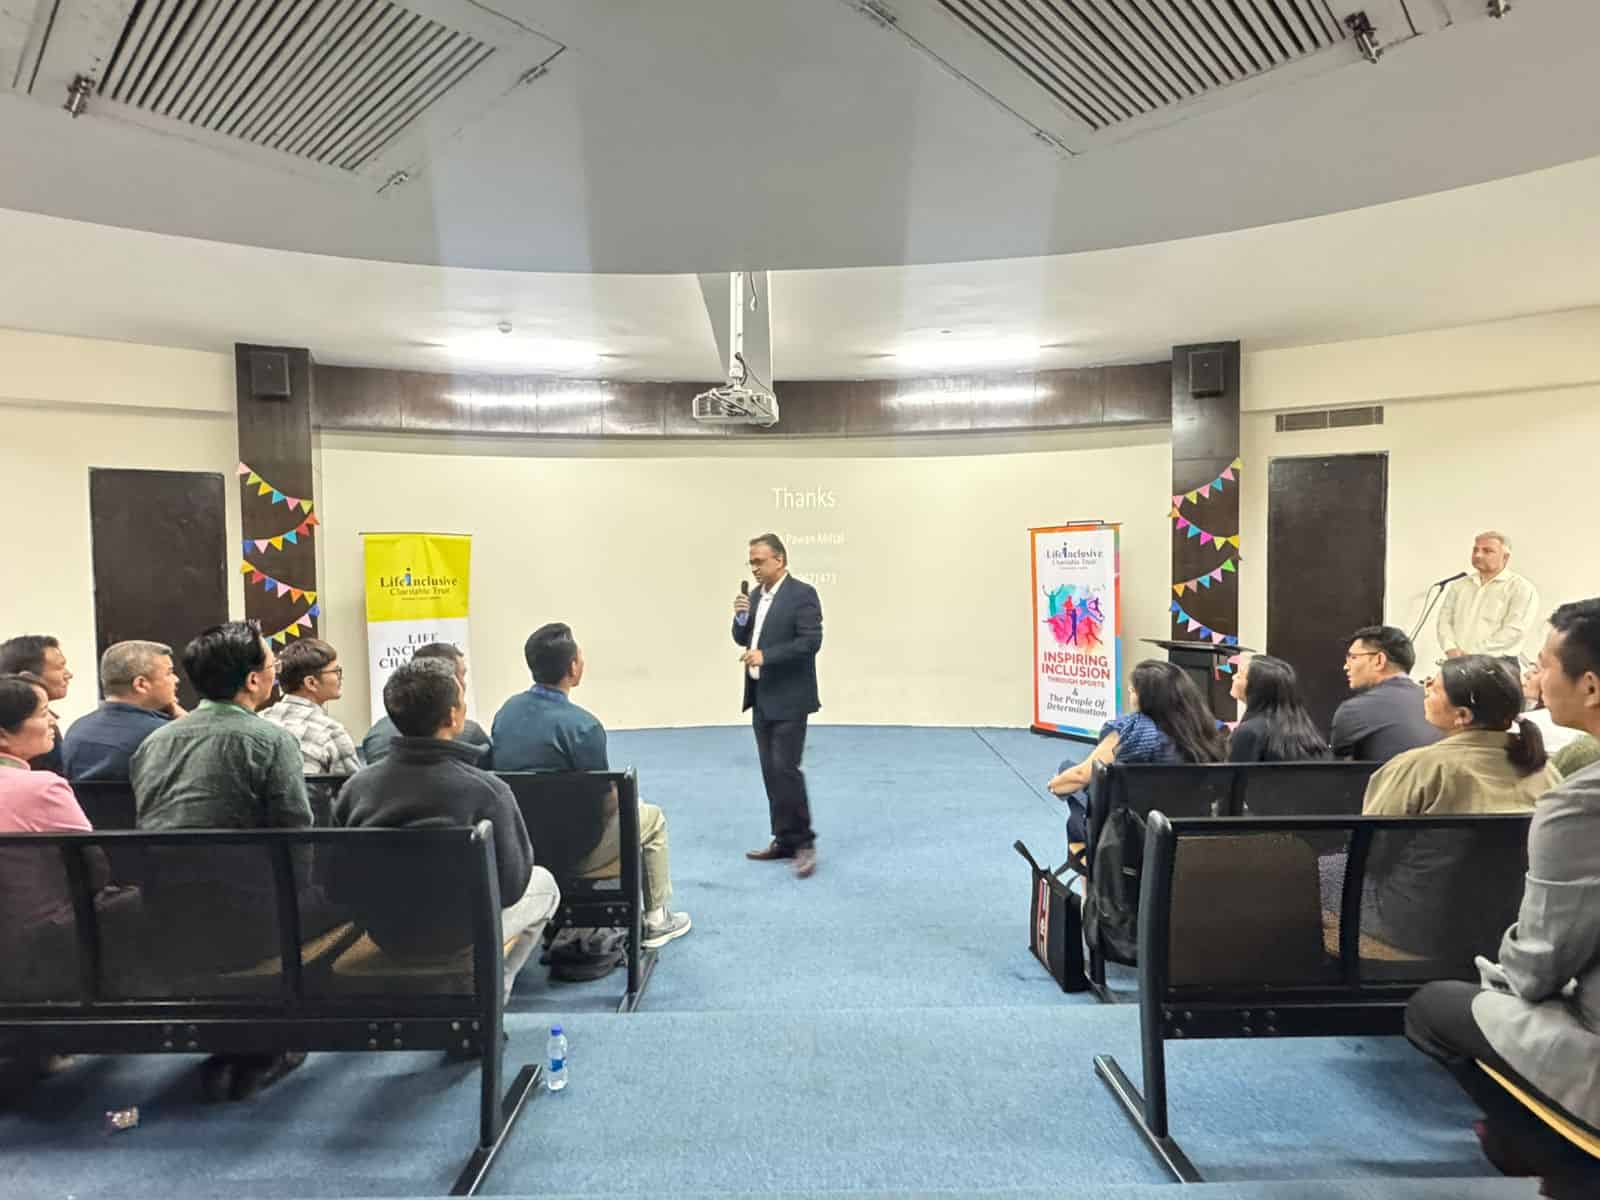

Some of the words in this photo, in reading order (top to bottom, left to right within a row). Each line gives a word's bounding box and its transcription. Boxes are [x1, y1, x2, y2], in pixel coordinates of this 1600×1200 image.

[771, 486, 836, 509] Thanks
[1044, 651, 1108, 667] INSPIRING
[1042, 663, 1110, 680] INCLUSION
[1050, 693, 1064, 703] The
[1065, 695, 1093, 706] People
[1094, 699, 1105, 709] Of
[1047, 702, 1107, 717] Determination
